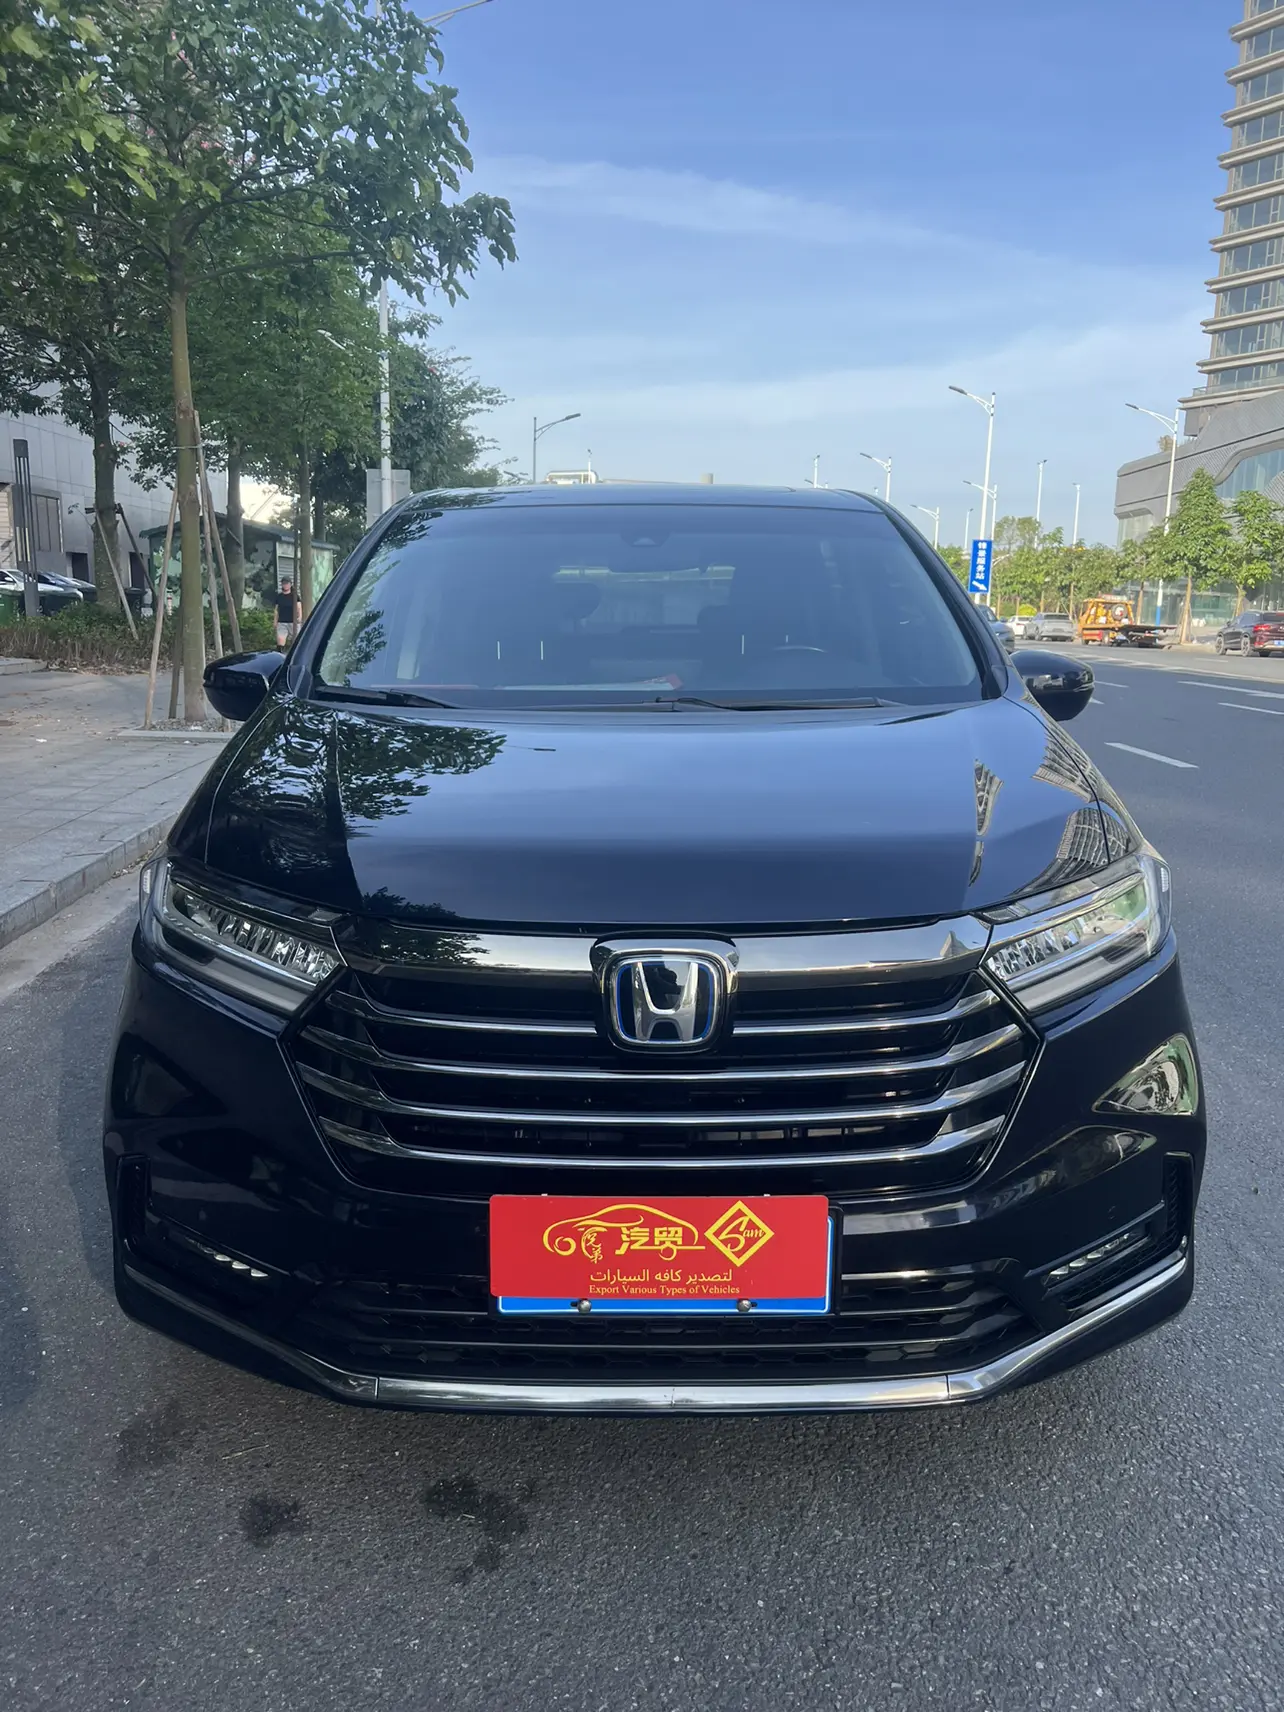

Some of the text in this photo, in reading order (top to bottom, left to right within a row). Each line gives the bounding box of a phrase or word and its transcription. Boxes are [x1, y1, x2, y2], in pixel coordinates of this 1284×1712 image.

[718, 1215, 765, 1252] Sam
[590, 1268, 733, 1285] لتصدير كافه السيارات
[589, 1284, 740, 1296] Export Various Types of Vehicles
